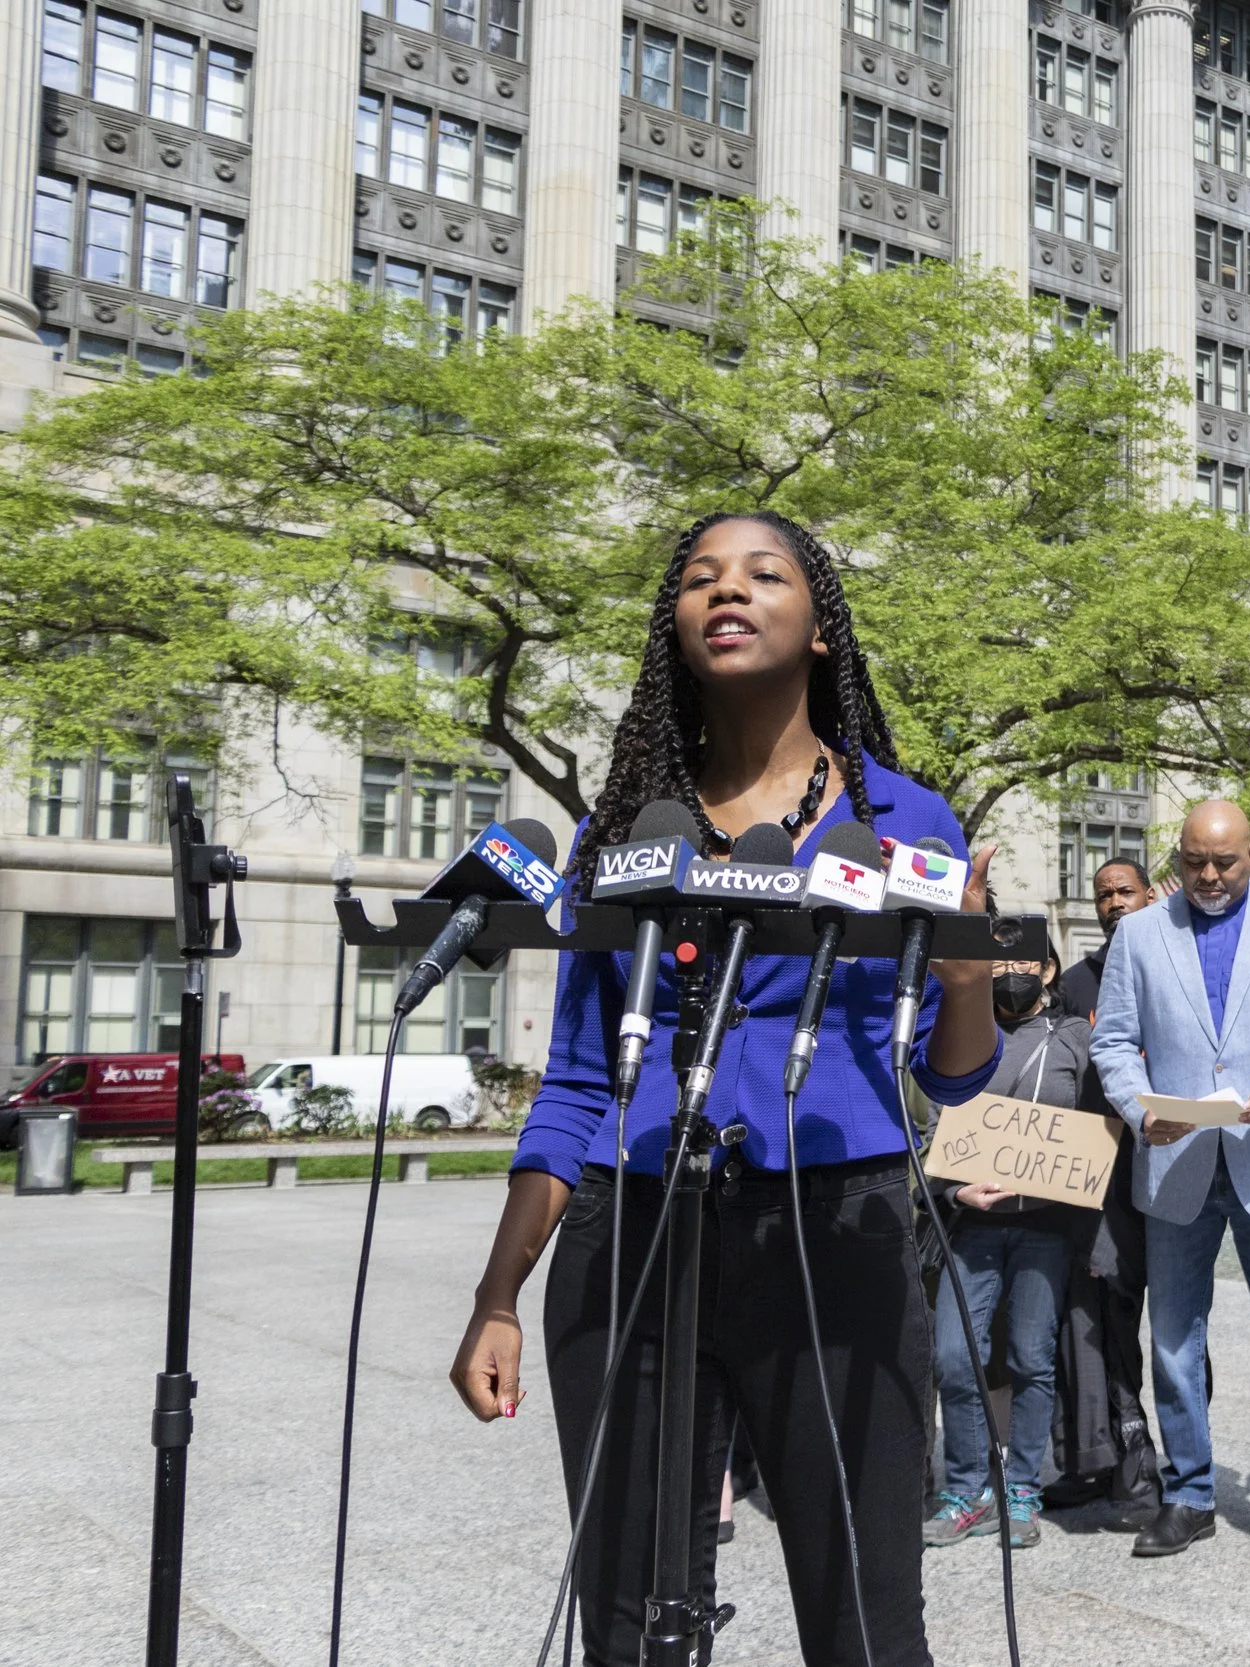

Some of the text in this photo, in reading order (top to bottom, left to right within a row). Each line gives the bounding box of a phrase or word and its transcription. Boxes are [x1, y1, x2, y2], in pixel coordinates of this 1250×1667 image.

[603, 843, 675, 876] WGN
[481, 847, 546, 904] NEWS
[523, 860, 558, 894] 5
[621, 871, 648, 881] NEWS
[691, 868, 773, 891] wttw
[824, 878, 870, 899] NOTICIERO
[897, 877, 954, 897] NOTICIAS
[900, 885, 949, 902] CHICAGO
[118, 1068, 166, 1081] A VET
[983, 1103, 1064, 1143] CARE
[942, 1130, 977, 1161] not
[993, 1146, 1109, 1196] CURFEW
